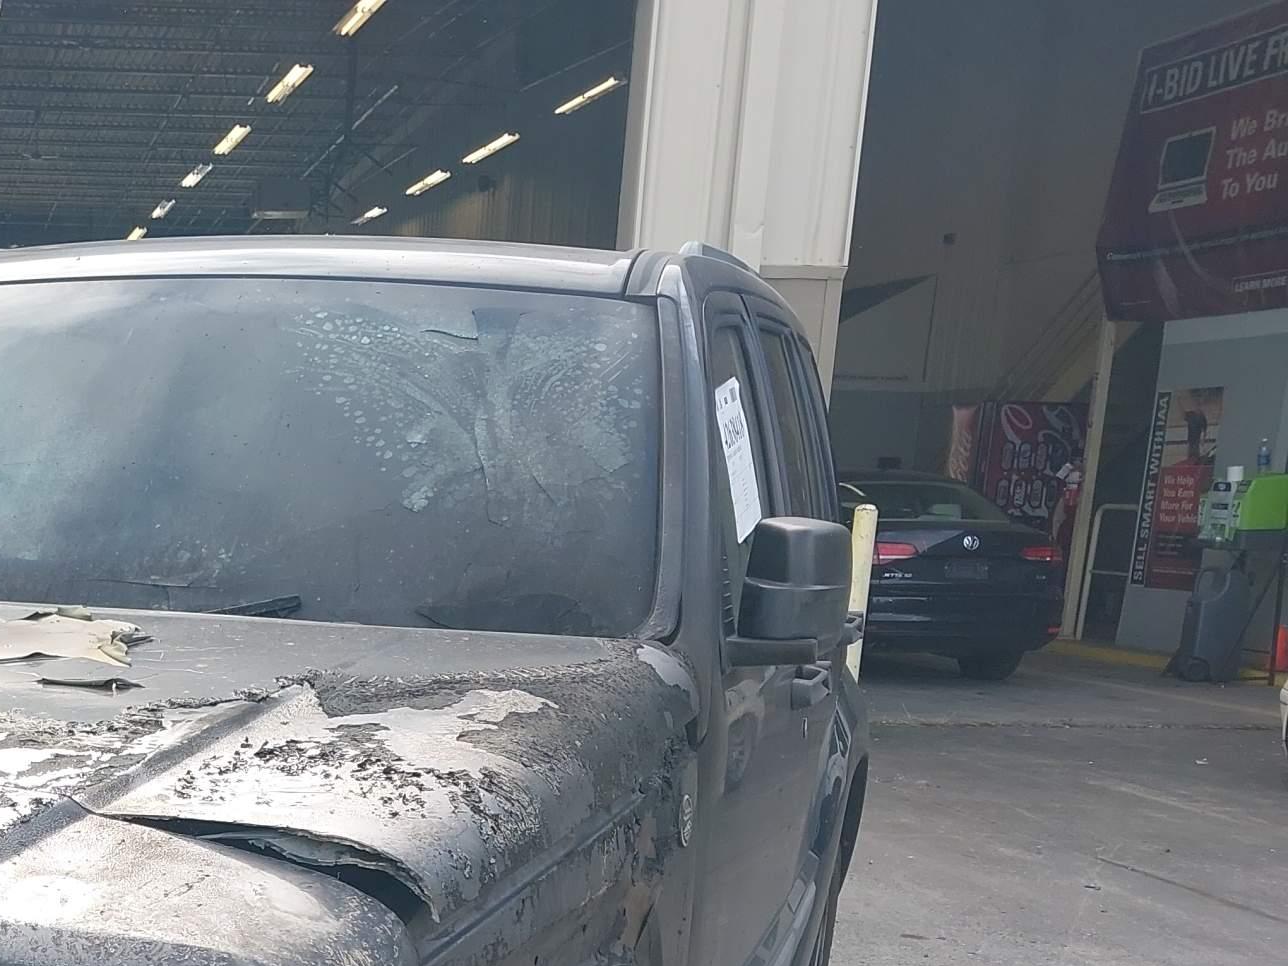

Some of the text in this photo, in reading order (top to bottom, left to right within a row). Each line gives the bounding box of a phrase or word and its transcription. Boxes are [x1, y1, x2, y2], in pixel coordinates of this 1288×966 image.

[1147, 60, 1203, 105] I-BID
[1208, 40, 1260, 88] LIVE
[1231, 117, 1257, 140] We
[1226, 148, 1257, 169] The
[1221, 172, 1278, 200] To You
[1133, 543, 1147, 581] SELL
[1140, 480, 1157, 539] SMART
[1149, 430, 1164, 475] WITH
